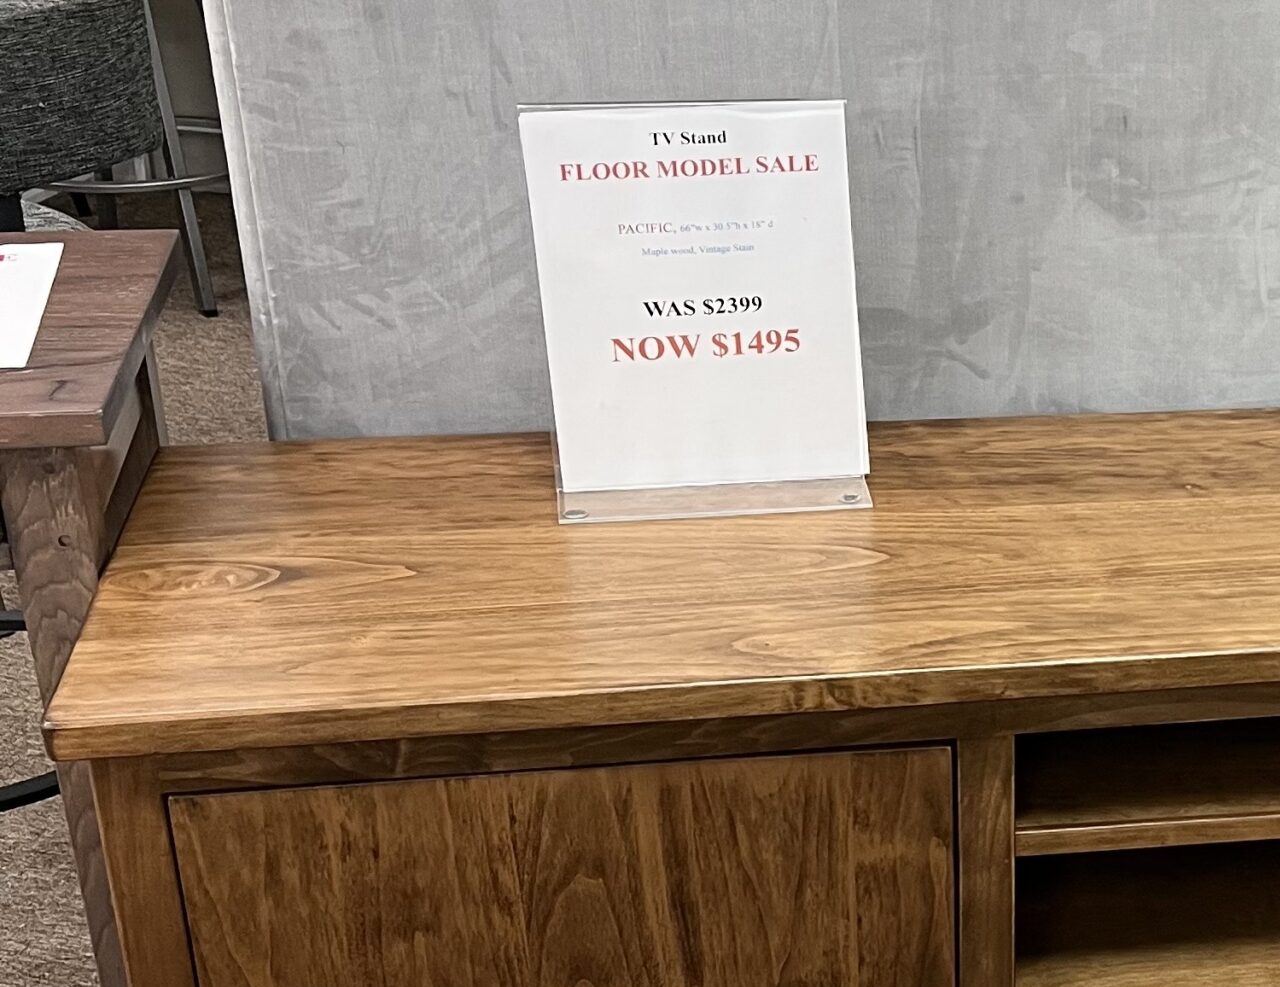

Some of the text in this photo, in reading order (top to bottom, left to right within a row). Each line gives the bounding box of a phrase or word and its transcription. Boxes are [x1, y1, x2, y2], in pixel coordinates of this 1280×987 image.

[649, 130, 727, 146] TV Stand
[559, 154, 819, 181] FLOOR MODEL SALE
[618, 222, 677, 235] PACIFIC,
[641, 243, 755, 257] Maple wood, Vintage Stain
[644, 294, 763, 318] WAS $2399
[610, 327, 801, 363] NOW $1495
